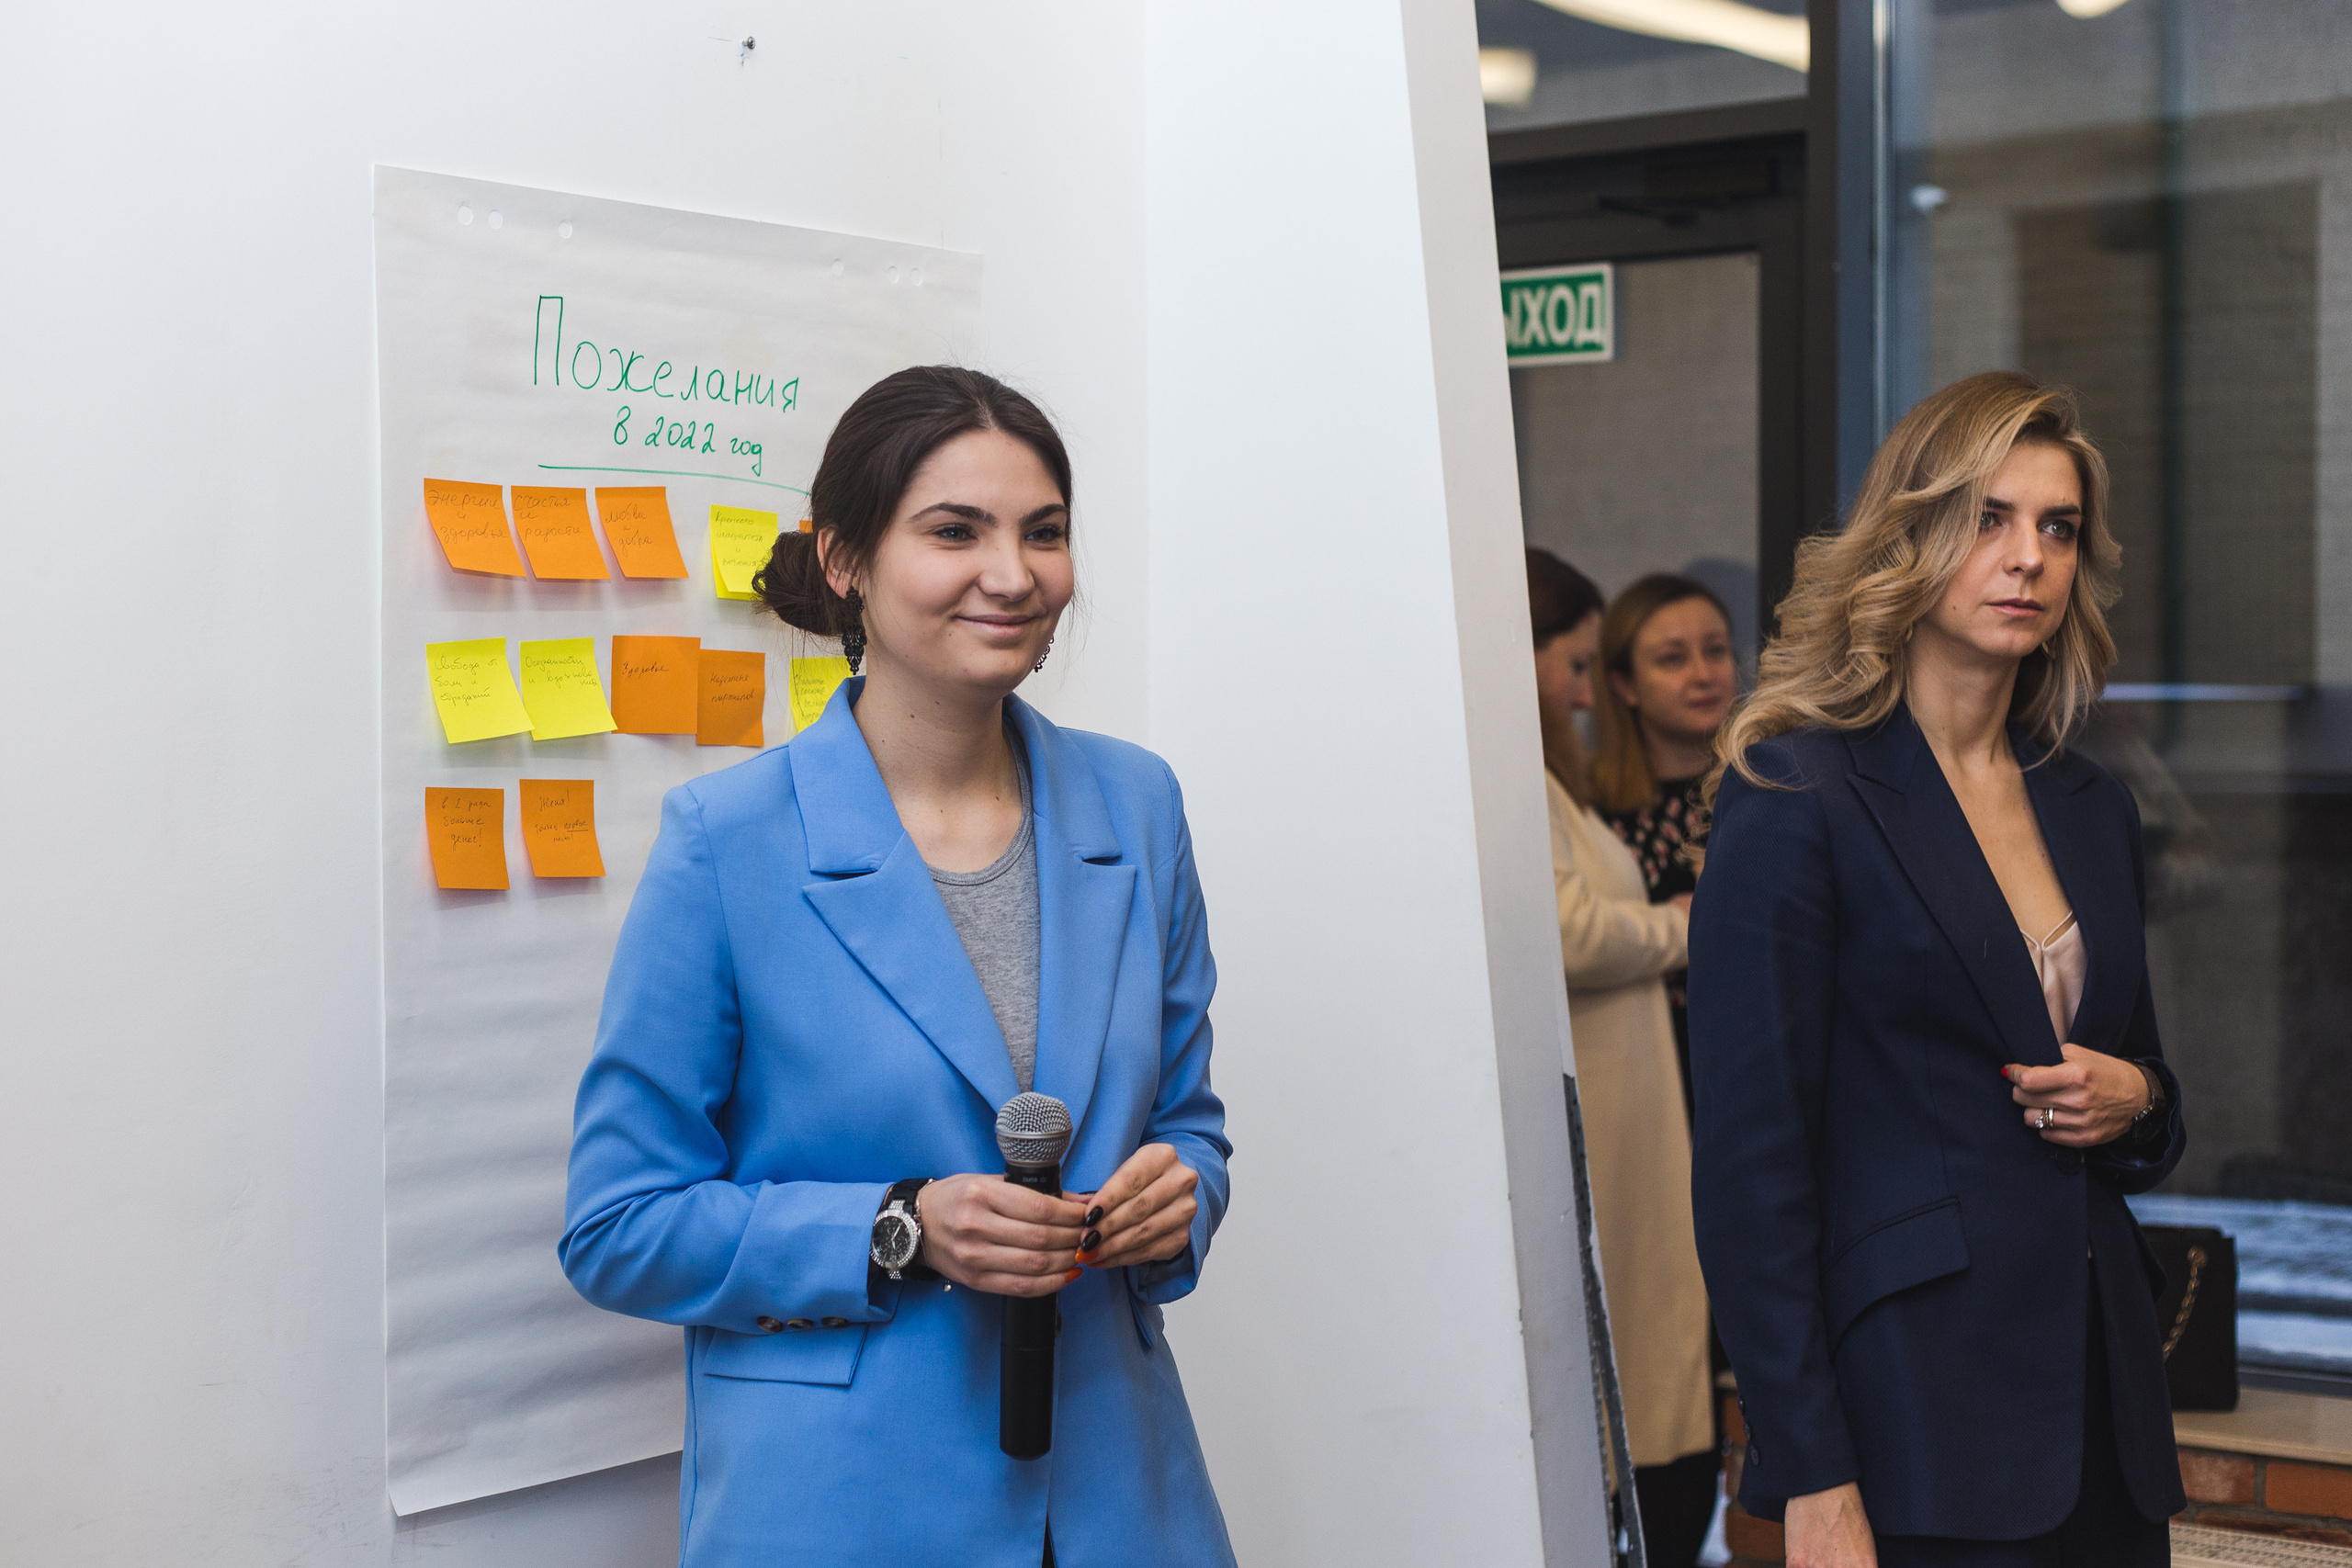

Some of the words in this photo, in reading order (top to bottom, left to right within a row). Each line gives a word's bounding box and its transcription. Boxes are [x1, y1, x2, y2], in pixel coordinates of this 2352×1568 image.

[534, 294, 799, 413] Пожелания
[613, 405, 632, 446] в
[644, 416, 717, 455] 2022
[729, 436, 763, 478] год
[457, 511, 467, 521] и
[439, 522, 509, 544] здоровья
[525, 526, 582, 542] радости
[618, 529, 653, 557] добра
[621, 661, 670, 680] Здоровье
[439, 687, 492, 706] страданий
[443, 816, 486, 828] больше
[450, 829, 482, 852] денег!
